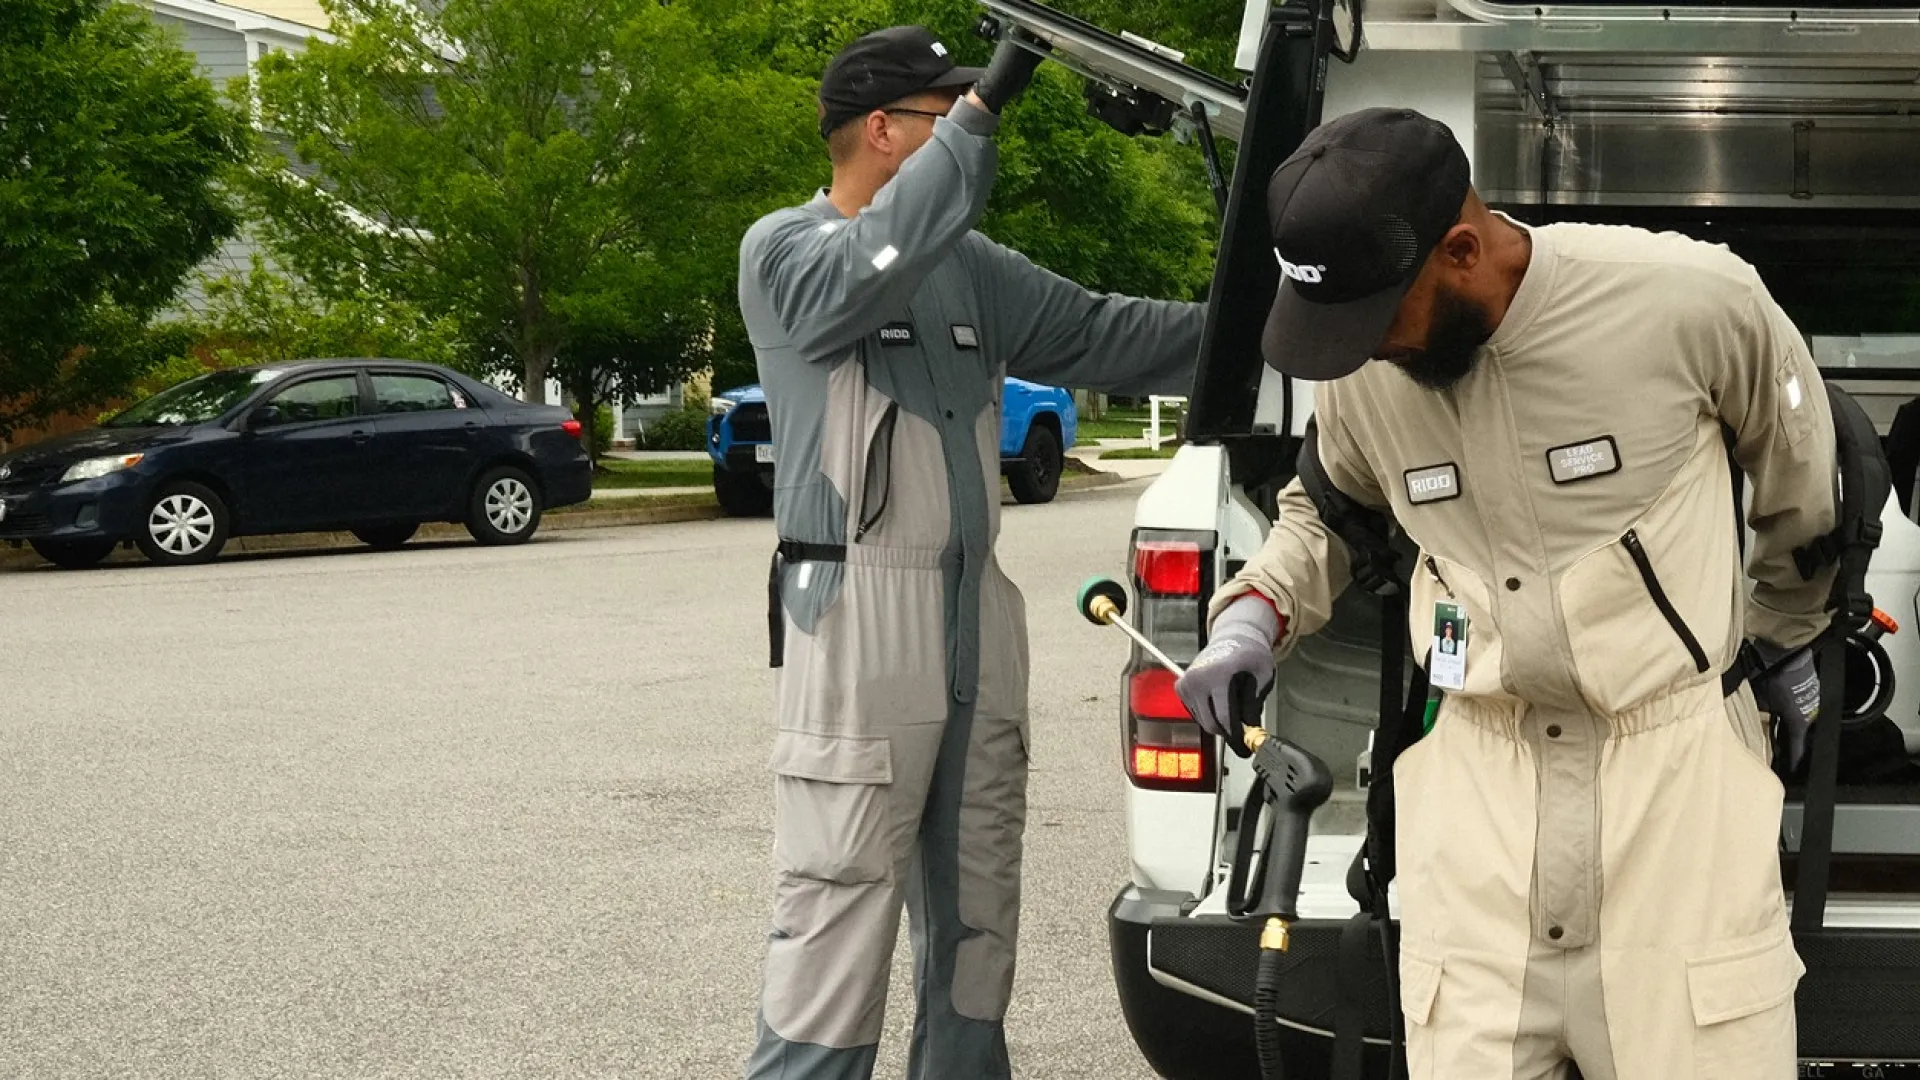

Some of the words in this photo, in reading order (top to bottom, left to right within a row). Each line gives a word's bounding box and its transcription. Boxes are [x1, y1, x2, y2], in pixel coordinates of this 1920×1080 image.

[880, 328, 911, 339] RIDD
[1566, 445, 1593, 457] LEAD
[1560, 451, 1605, 468] SERVICE
[1572, 463, 1595, 476] PRO
[1411, 474, 1450, 493] RIDD
